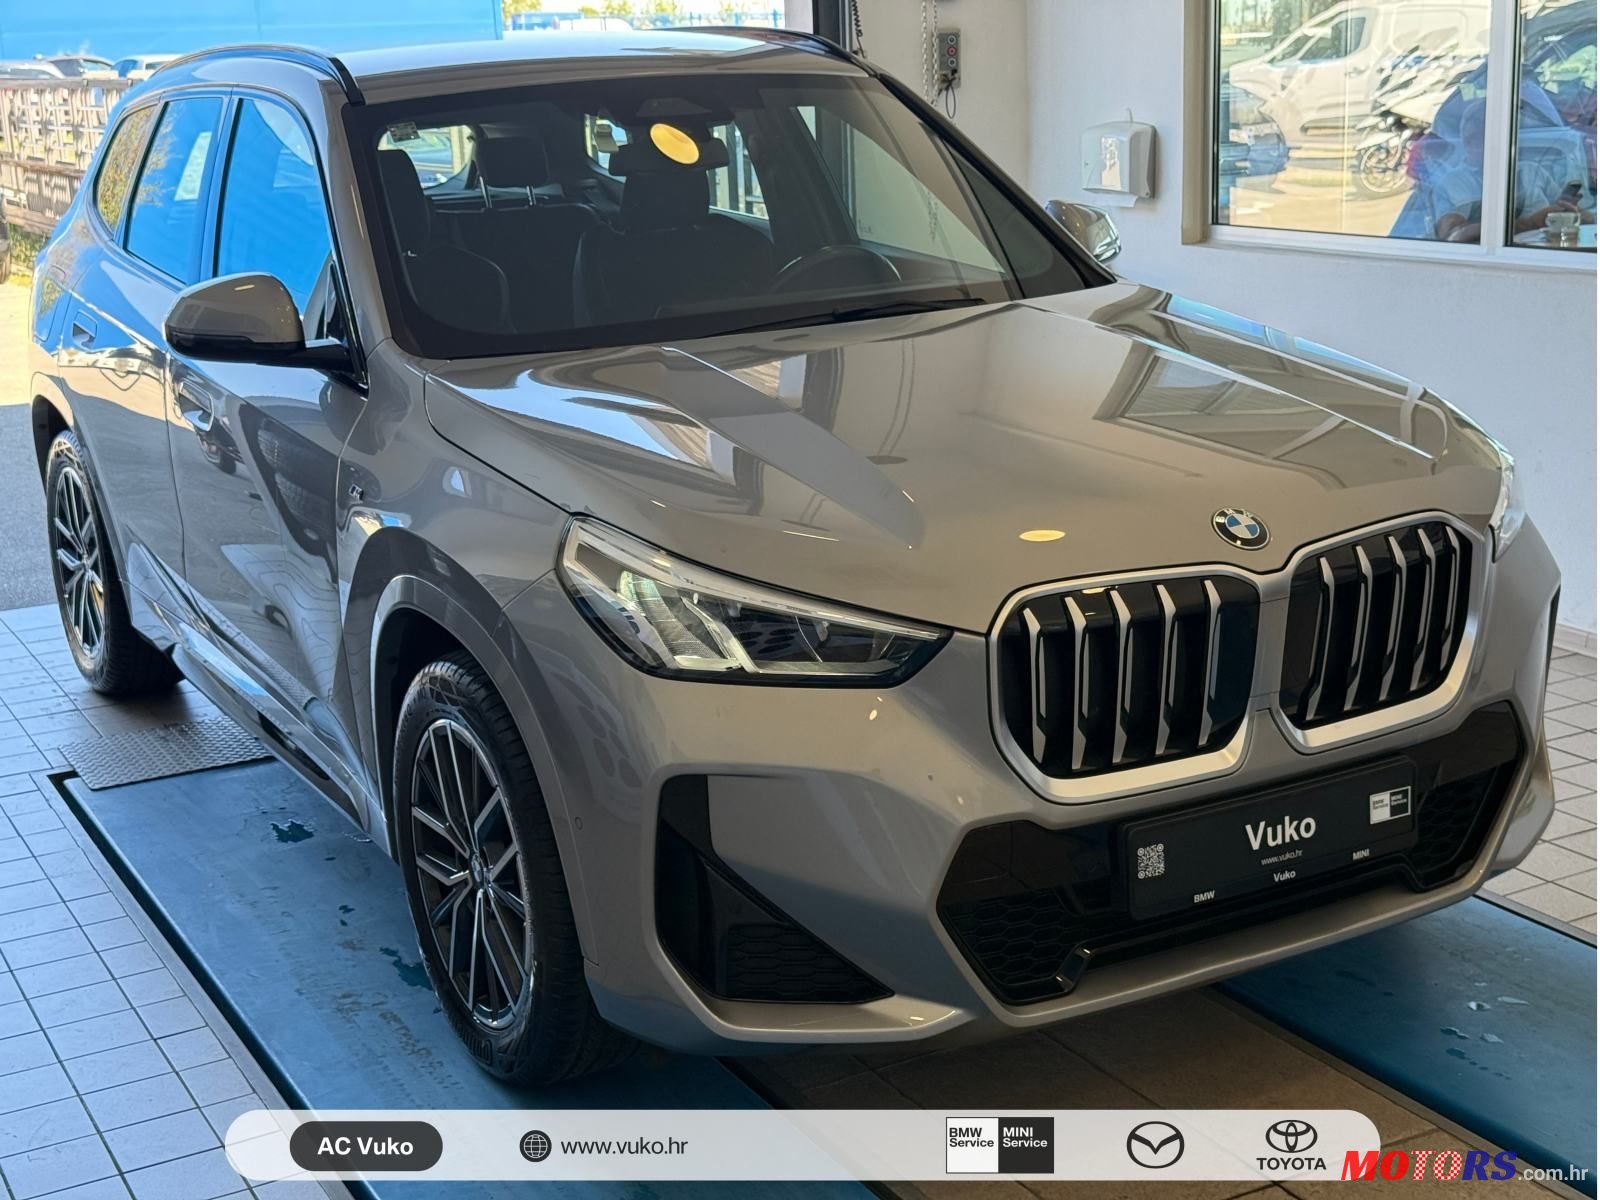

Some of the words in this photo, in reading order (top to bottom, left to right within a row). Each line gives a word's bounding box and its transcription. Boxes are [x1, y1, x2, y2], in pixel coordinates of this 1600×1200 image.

[1245, 815, 1316, 850] Vuko
[1352, 848, 1370, 860] MINI
[1273, 870, 1296, 882] Vuko
[1193, 890, 1215, 903] BMW
